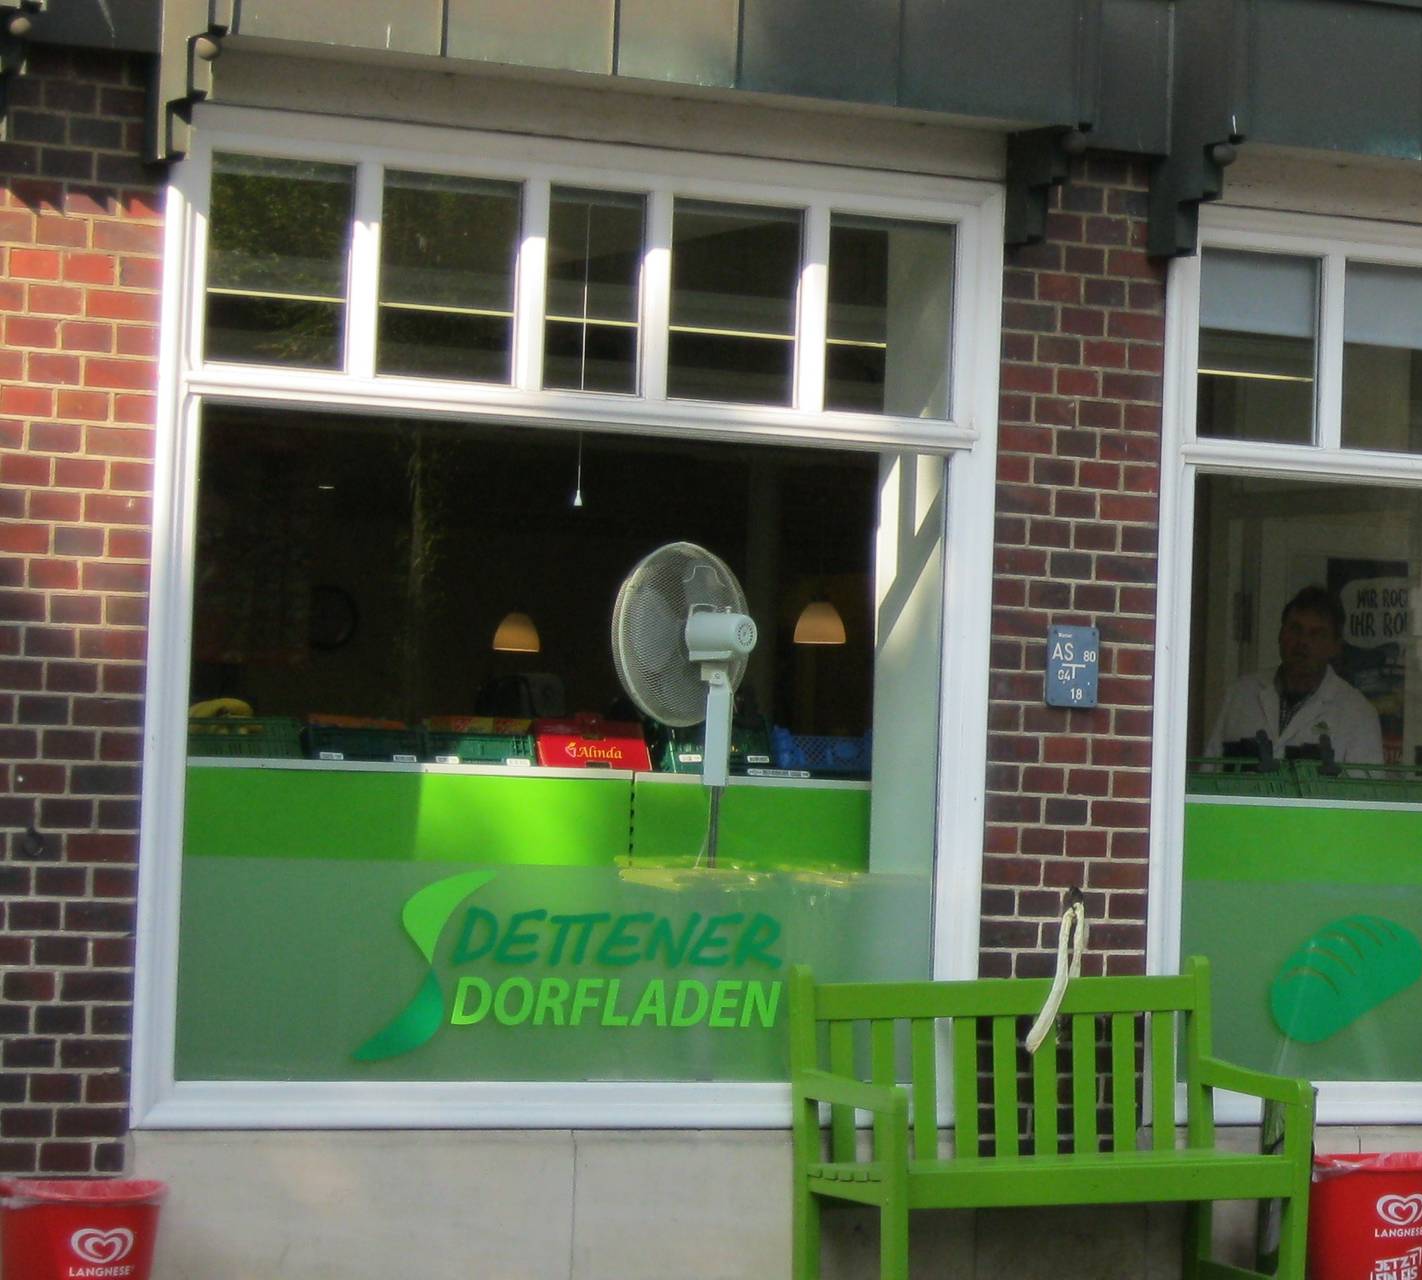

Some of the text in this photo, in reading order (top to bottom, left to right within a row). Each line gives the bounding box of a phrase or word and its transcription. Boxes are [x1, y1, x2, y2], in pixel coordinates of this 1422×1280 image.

[1350, 611, 1376, 638] IHR
[1052, 642, 1097, 663] AS 80
[576, 745, 623, 760] Alinda
[451, 906, 784, 970] DETTENER
[451, 976, 783, 1029] DORFLADEN
[68, 1265, 132, 1277] LANGNESE
